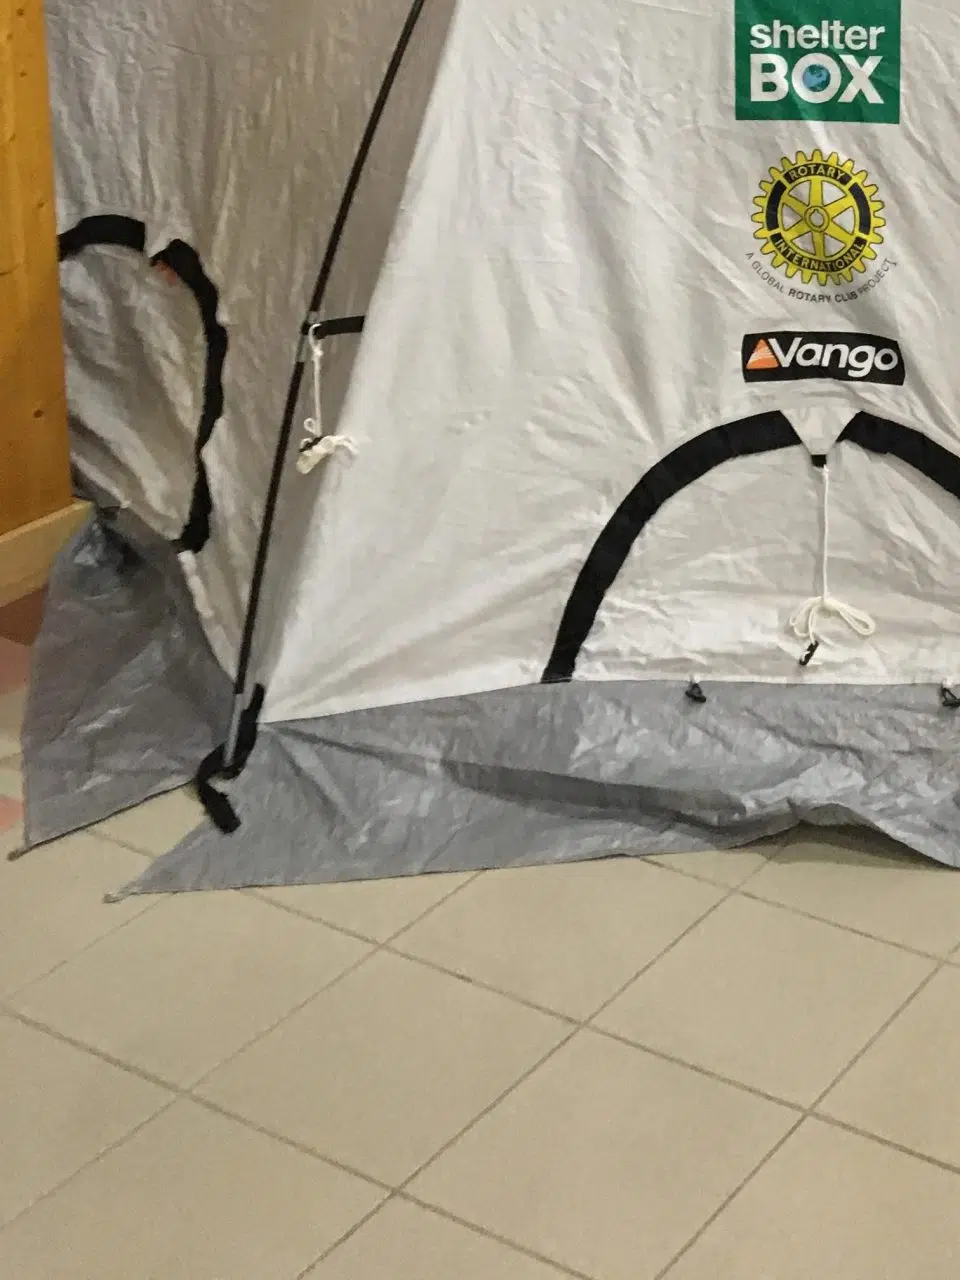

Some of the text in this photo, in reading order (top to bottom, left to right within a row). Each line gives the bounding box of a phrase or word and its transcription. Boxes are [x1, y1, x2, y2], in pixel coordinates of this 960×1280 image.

[750, 20, 886, 50] shelter
[750, 52, 885, 104] BOX
[790, 164, 846, 180] ROTARY
[775, 238, 865, 271] INTERNATIONAL
[752, 260, 785, 293] GLOBAL
[788, 288, 832, 303] ROTARY
[834, 291, 858, 303] CLUB
[857, 257, 898, 296] PROJECT
[768, 337, 899, 378] Vango
